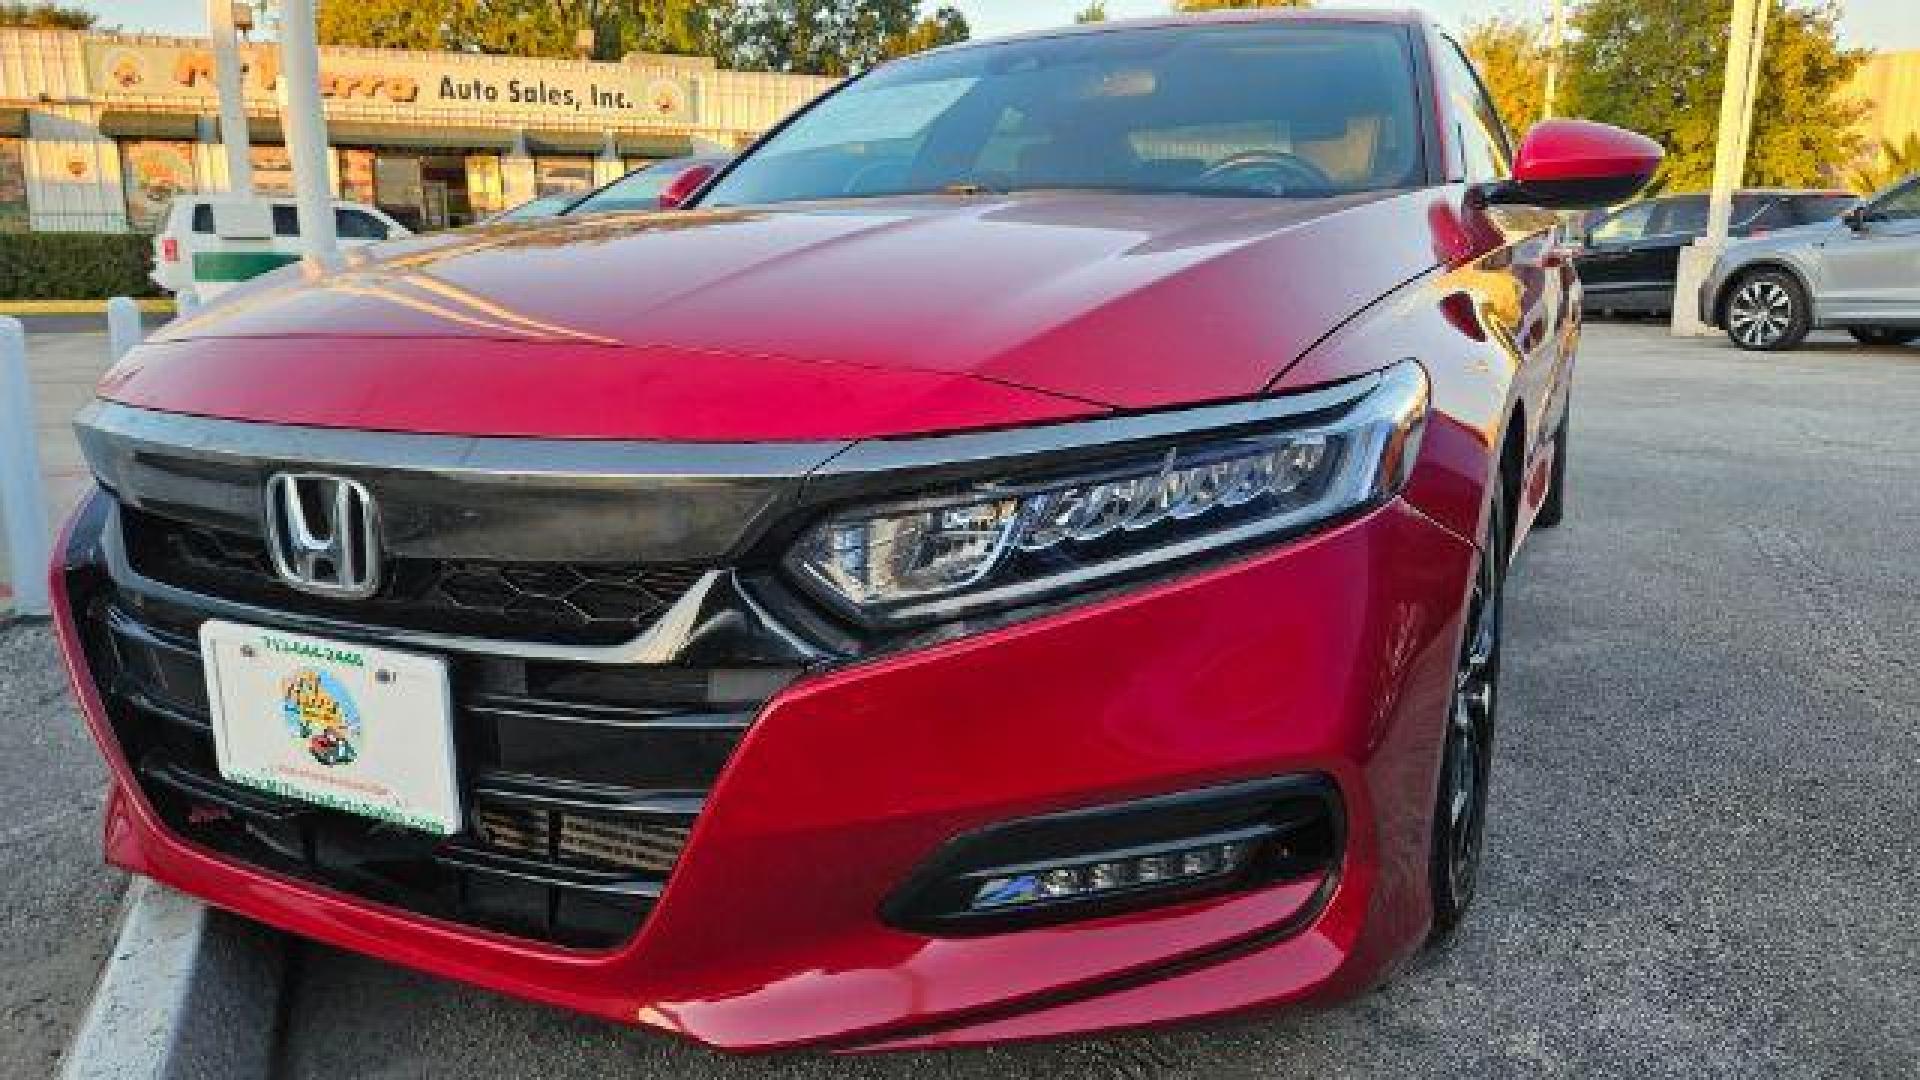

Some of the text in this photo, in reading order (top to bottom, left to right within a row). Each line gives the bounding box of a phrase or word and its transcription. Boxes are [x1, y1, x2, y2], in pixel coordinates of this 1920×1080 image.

[439, 74, 499, 101] Auto
[509, 77, 583, 111] Sales,
[590, 83, 634, 109] Inc.
